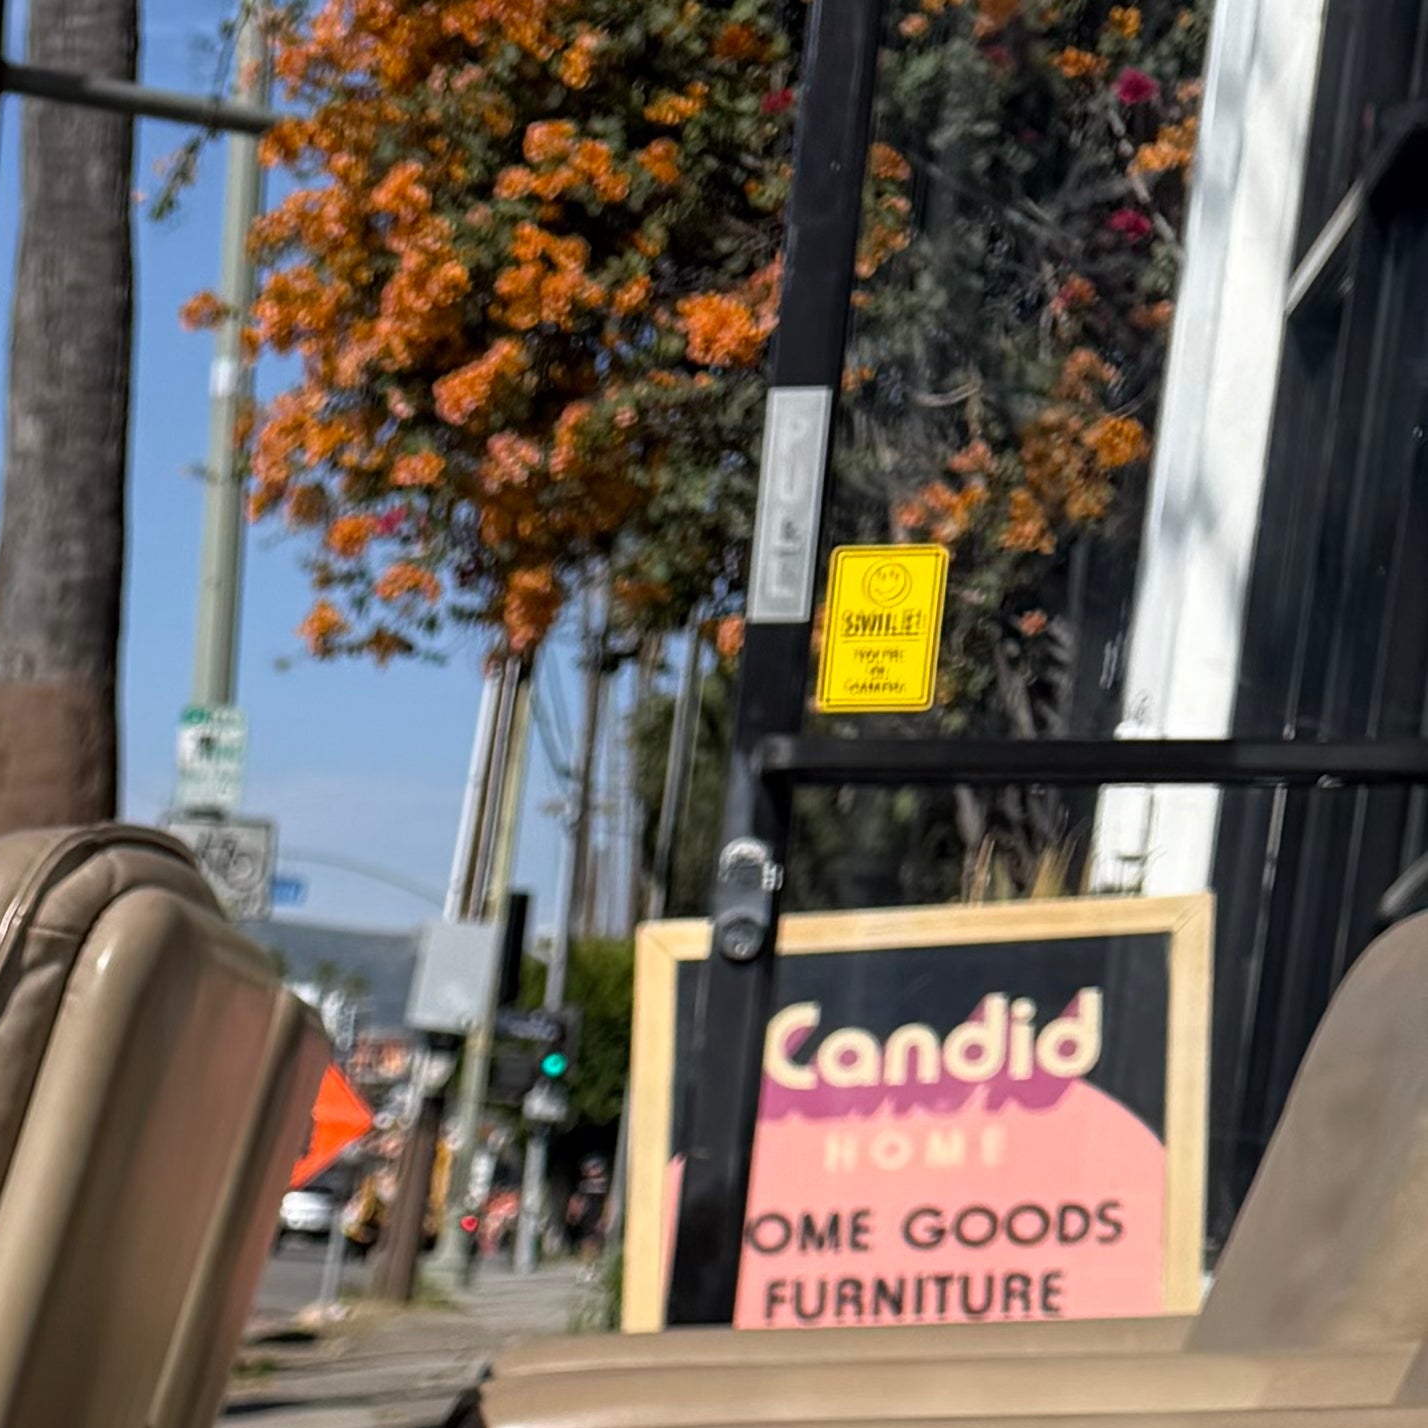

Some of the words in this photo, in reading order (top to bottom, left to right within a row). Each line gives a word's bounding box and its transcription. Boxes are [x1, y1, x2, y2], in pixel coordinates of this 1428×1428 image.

[763, 986, 1105, 1090] Candid
[823, 1126, 1008, 1173] HOME
[746, 1208, 872, 1254] OME
[902, 1200, 1125, 1251] GOODS
[764, 1272, 1066, 1323] FURNITURE
